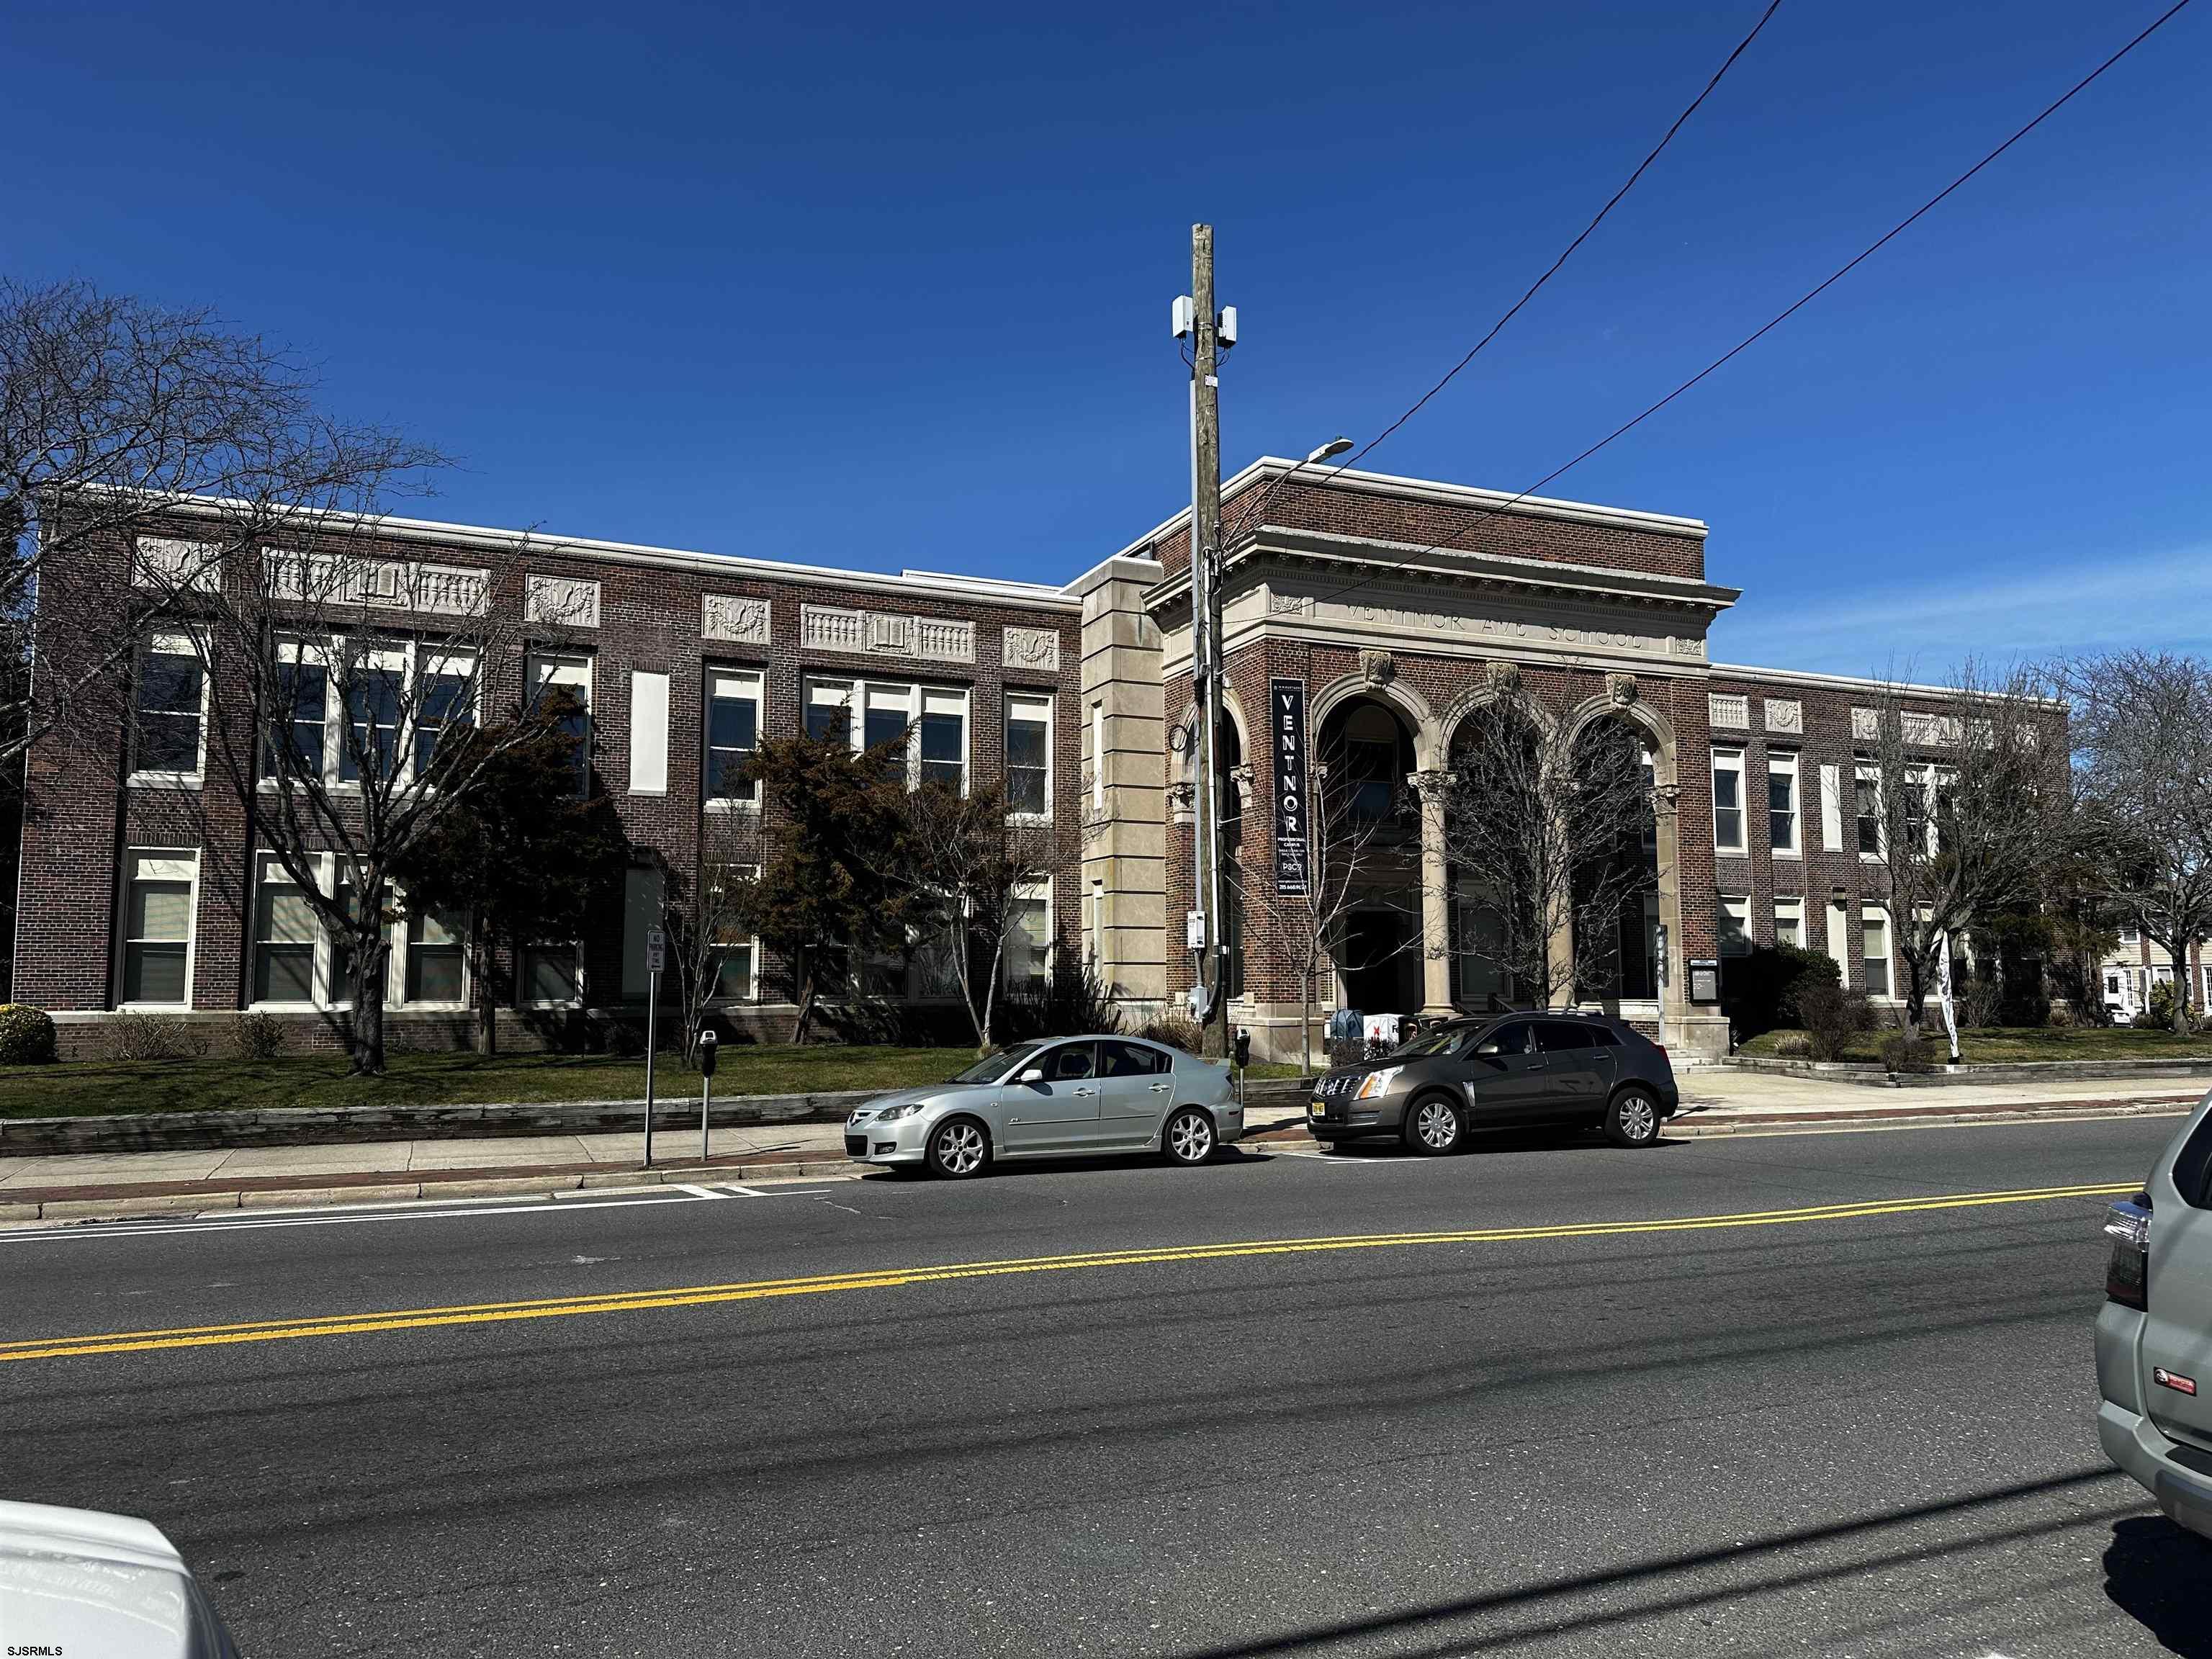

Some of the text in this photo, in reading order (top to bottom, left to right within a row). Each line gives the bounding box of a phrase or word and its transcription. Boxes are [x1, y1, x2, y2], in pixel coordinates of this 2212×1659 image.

[1346, 603, 1642, 648] VENTNOR AVE SCHOOL
[1282, 695, 1298, 832] VENTNOR
